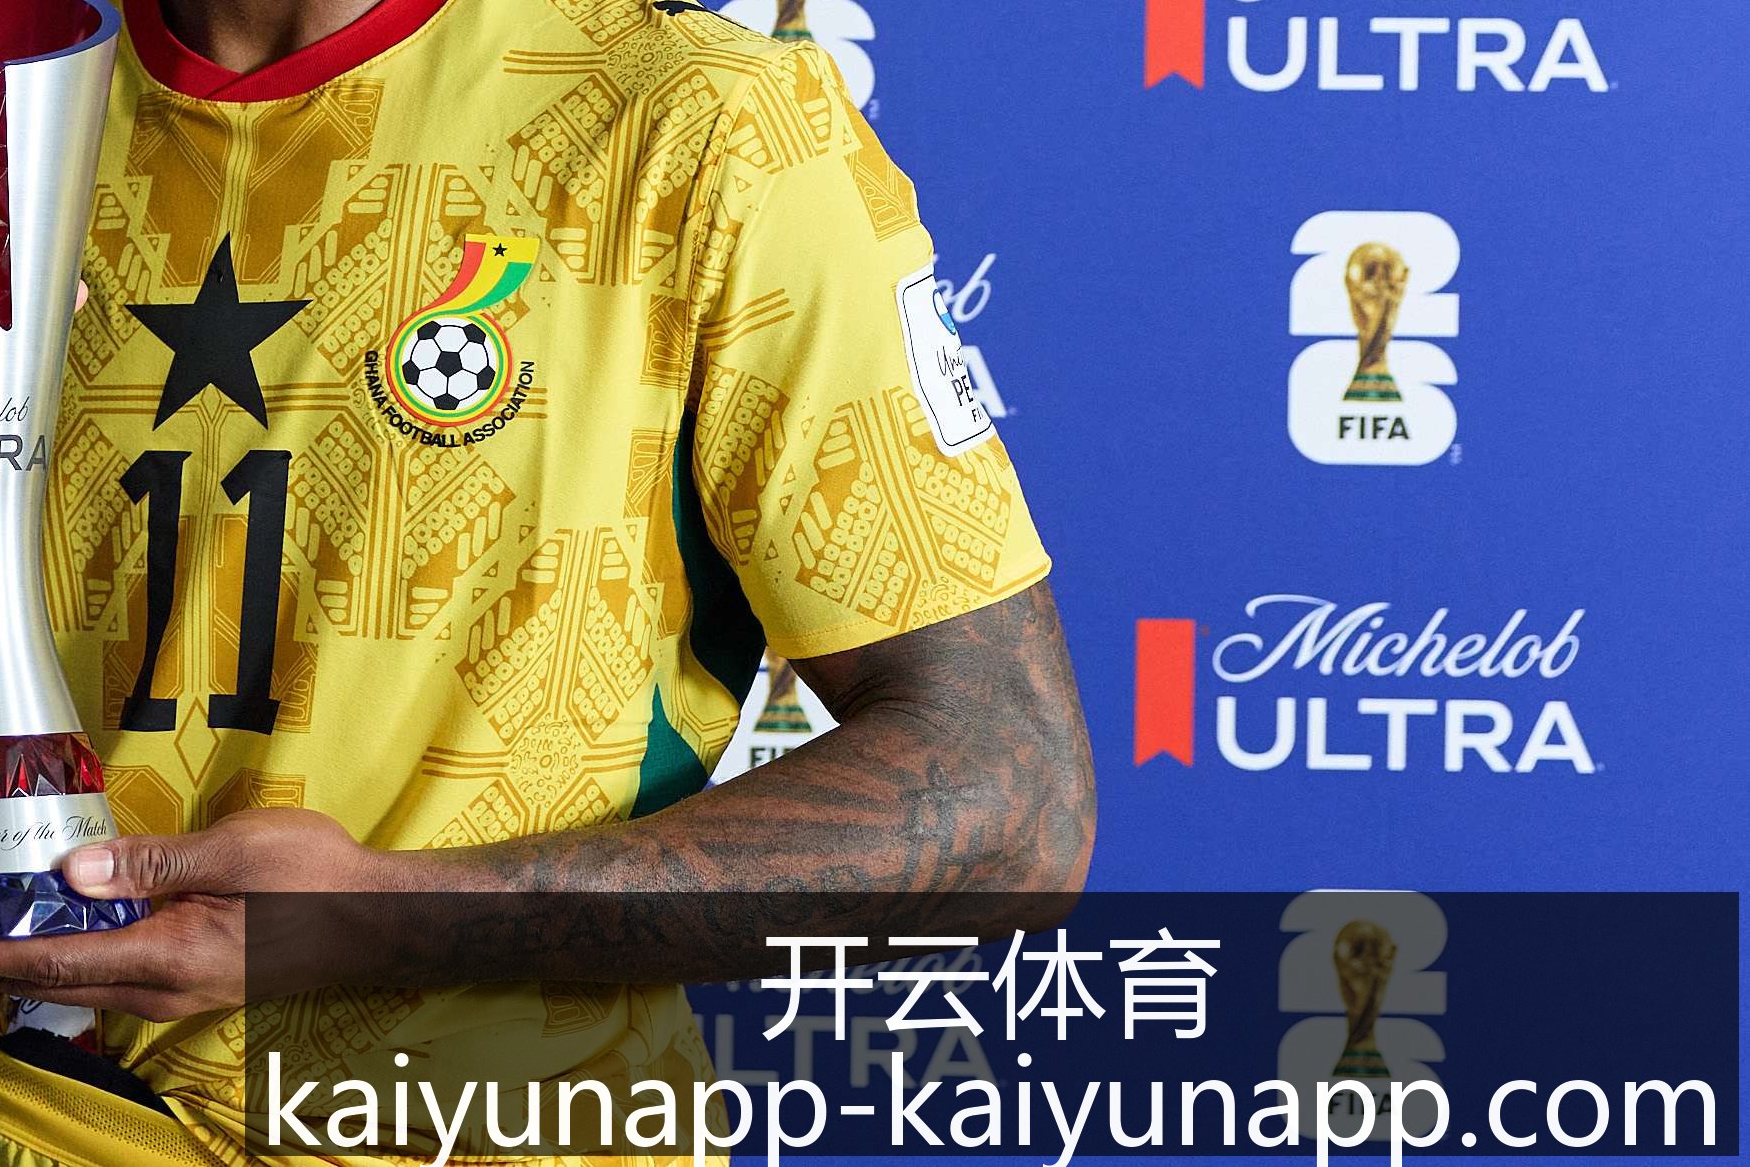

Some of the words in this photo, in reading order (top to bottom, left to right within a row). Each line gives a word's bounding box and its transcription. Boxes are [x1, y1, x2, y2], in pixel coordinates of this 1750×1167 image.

[1228, 16, 1611, 94] ULTRA
[364, 350, 388, 409] GHANA
[381, 405, 461, 448] FOOTBALL
[463, 361, 535, 446] ASSOCIATION
[1338, 416, 1410, 440] FIFA
[118, 449, 292, 736] 11
[1213, 594, 1587, 684] Michelob
[751, 746, 795, 769] FI
[1217, 696, 1597, 776] ULTRA
[3, 827, 30, 851] of
[33, 821, 56, 841] the
[62, 815, 107, 841] Match
[693, 1013, 1000, 1089] LTRA
[1327, 1091, 1393, 1116] FIA
